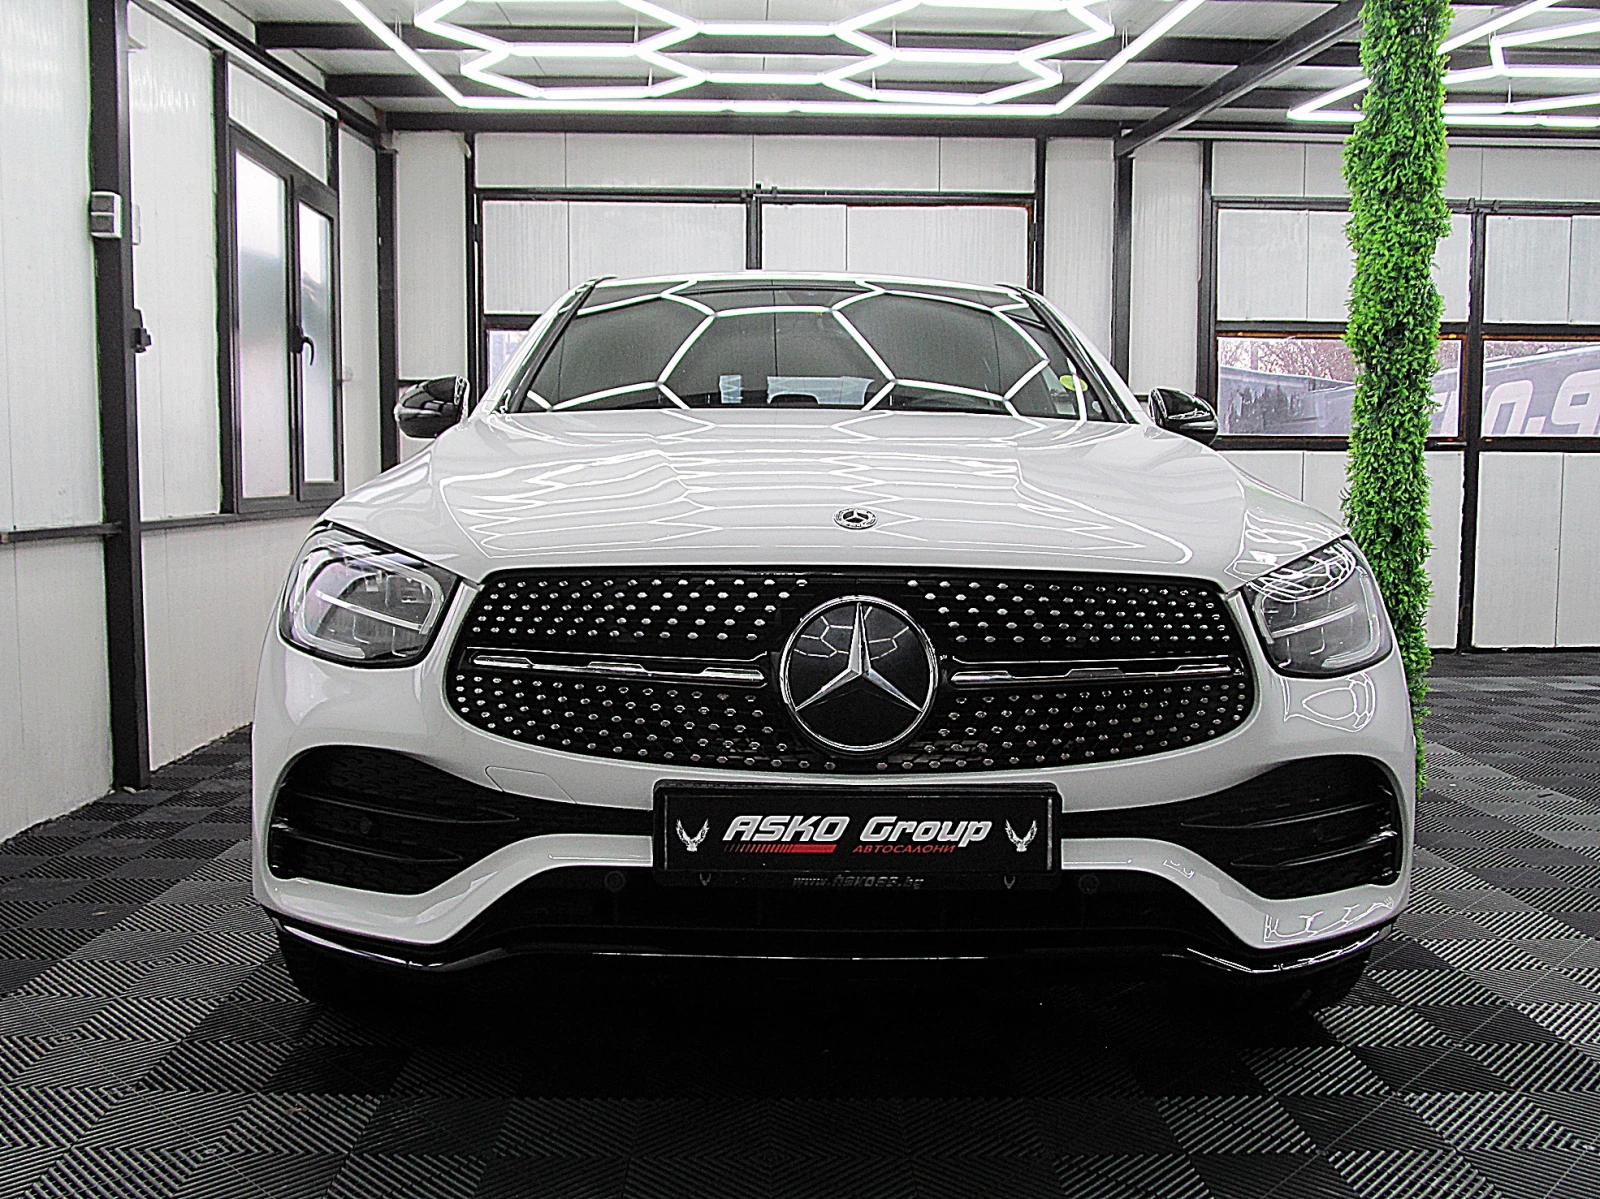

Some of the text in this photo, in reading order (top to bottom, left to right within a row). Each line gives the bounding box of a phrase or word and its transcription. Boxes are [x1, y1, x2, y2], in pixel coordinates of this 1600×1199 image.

[722, 815, 993, 848] ASKO Group
[852, 844, 956, 854] АВТОСАЛОНИ
